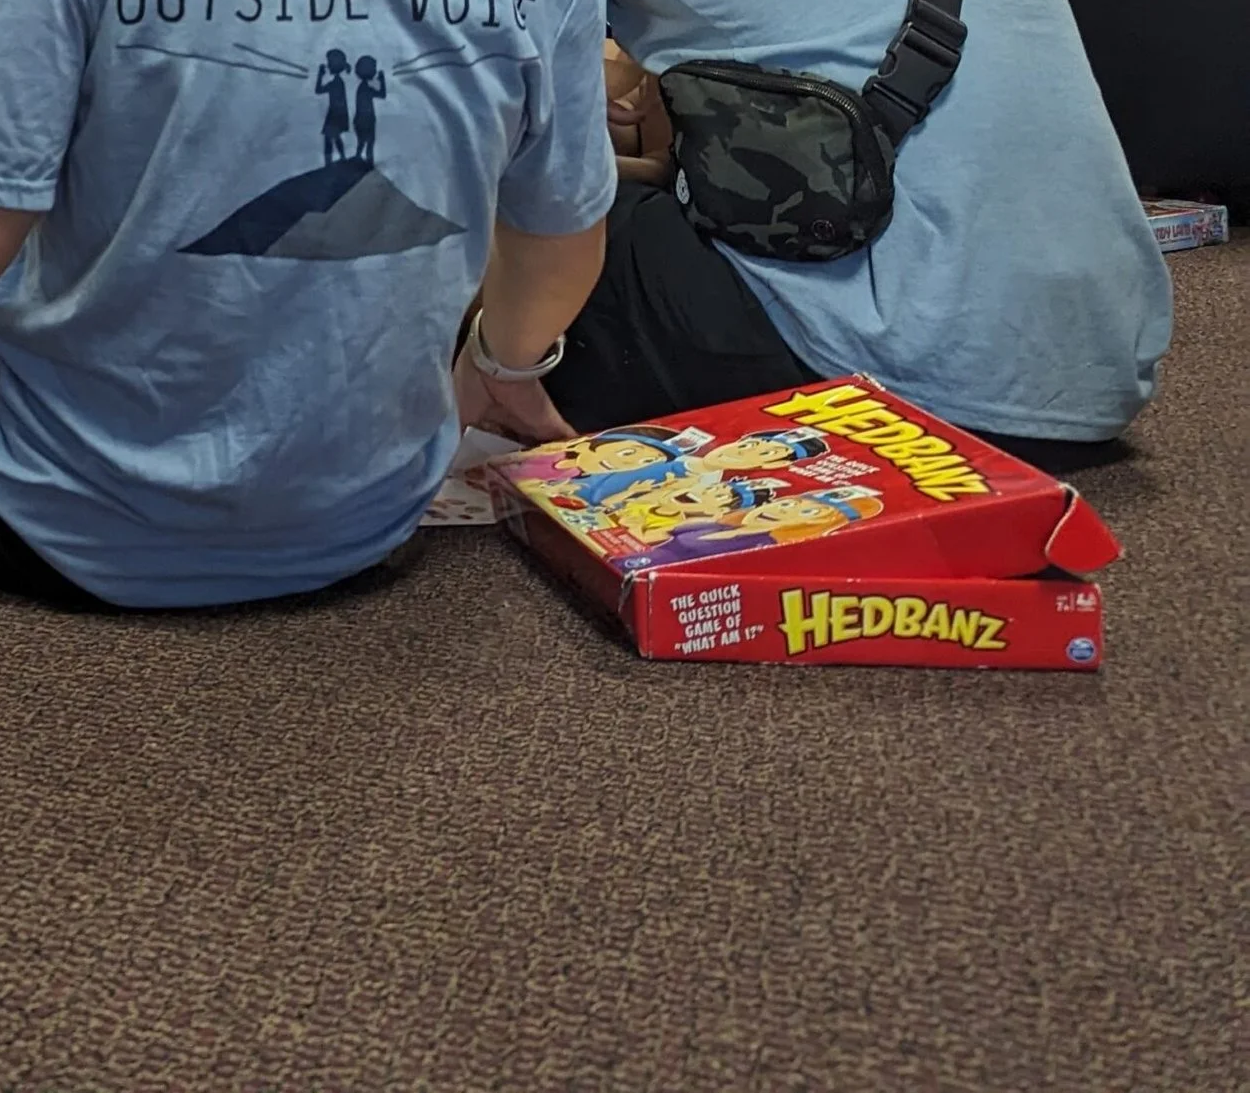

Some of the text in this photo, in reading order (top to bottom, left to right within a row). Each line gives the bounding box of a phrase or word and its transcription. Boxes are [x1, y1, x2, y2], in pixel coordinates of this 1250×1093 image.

[763, 383, 996, 503] HEDBANZ
[670, 584, 741, 611] THE QUICK
[678, 599, 741, 625] QUESTION
[778, 587, 1007, 656] HEDBANZ
[685, 614, 741, 638] GAME OF
[721, 630, 741, 646] AM
